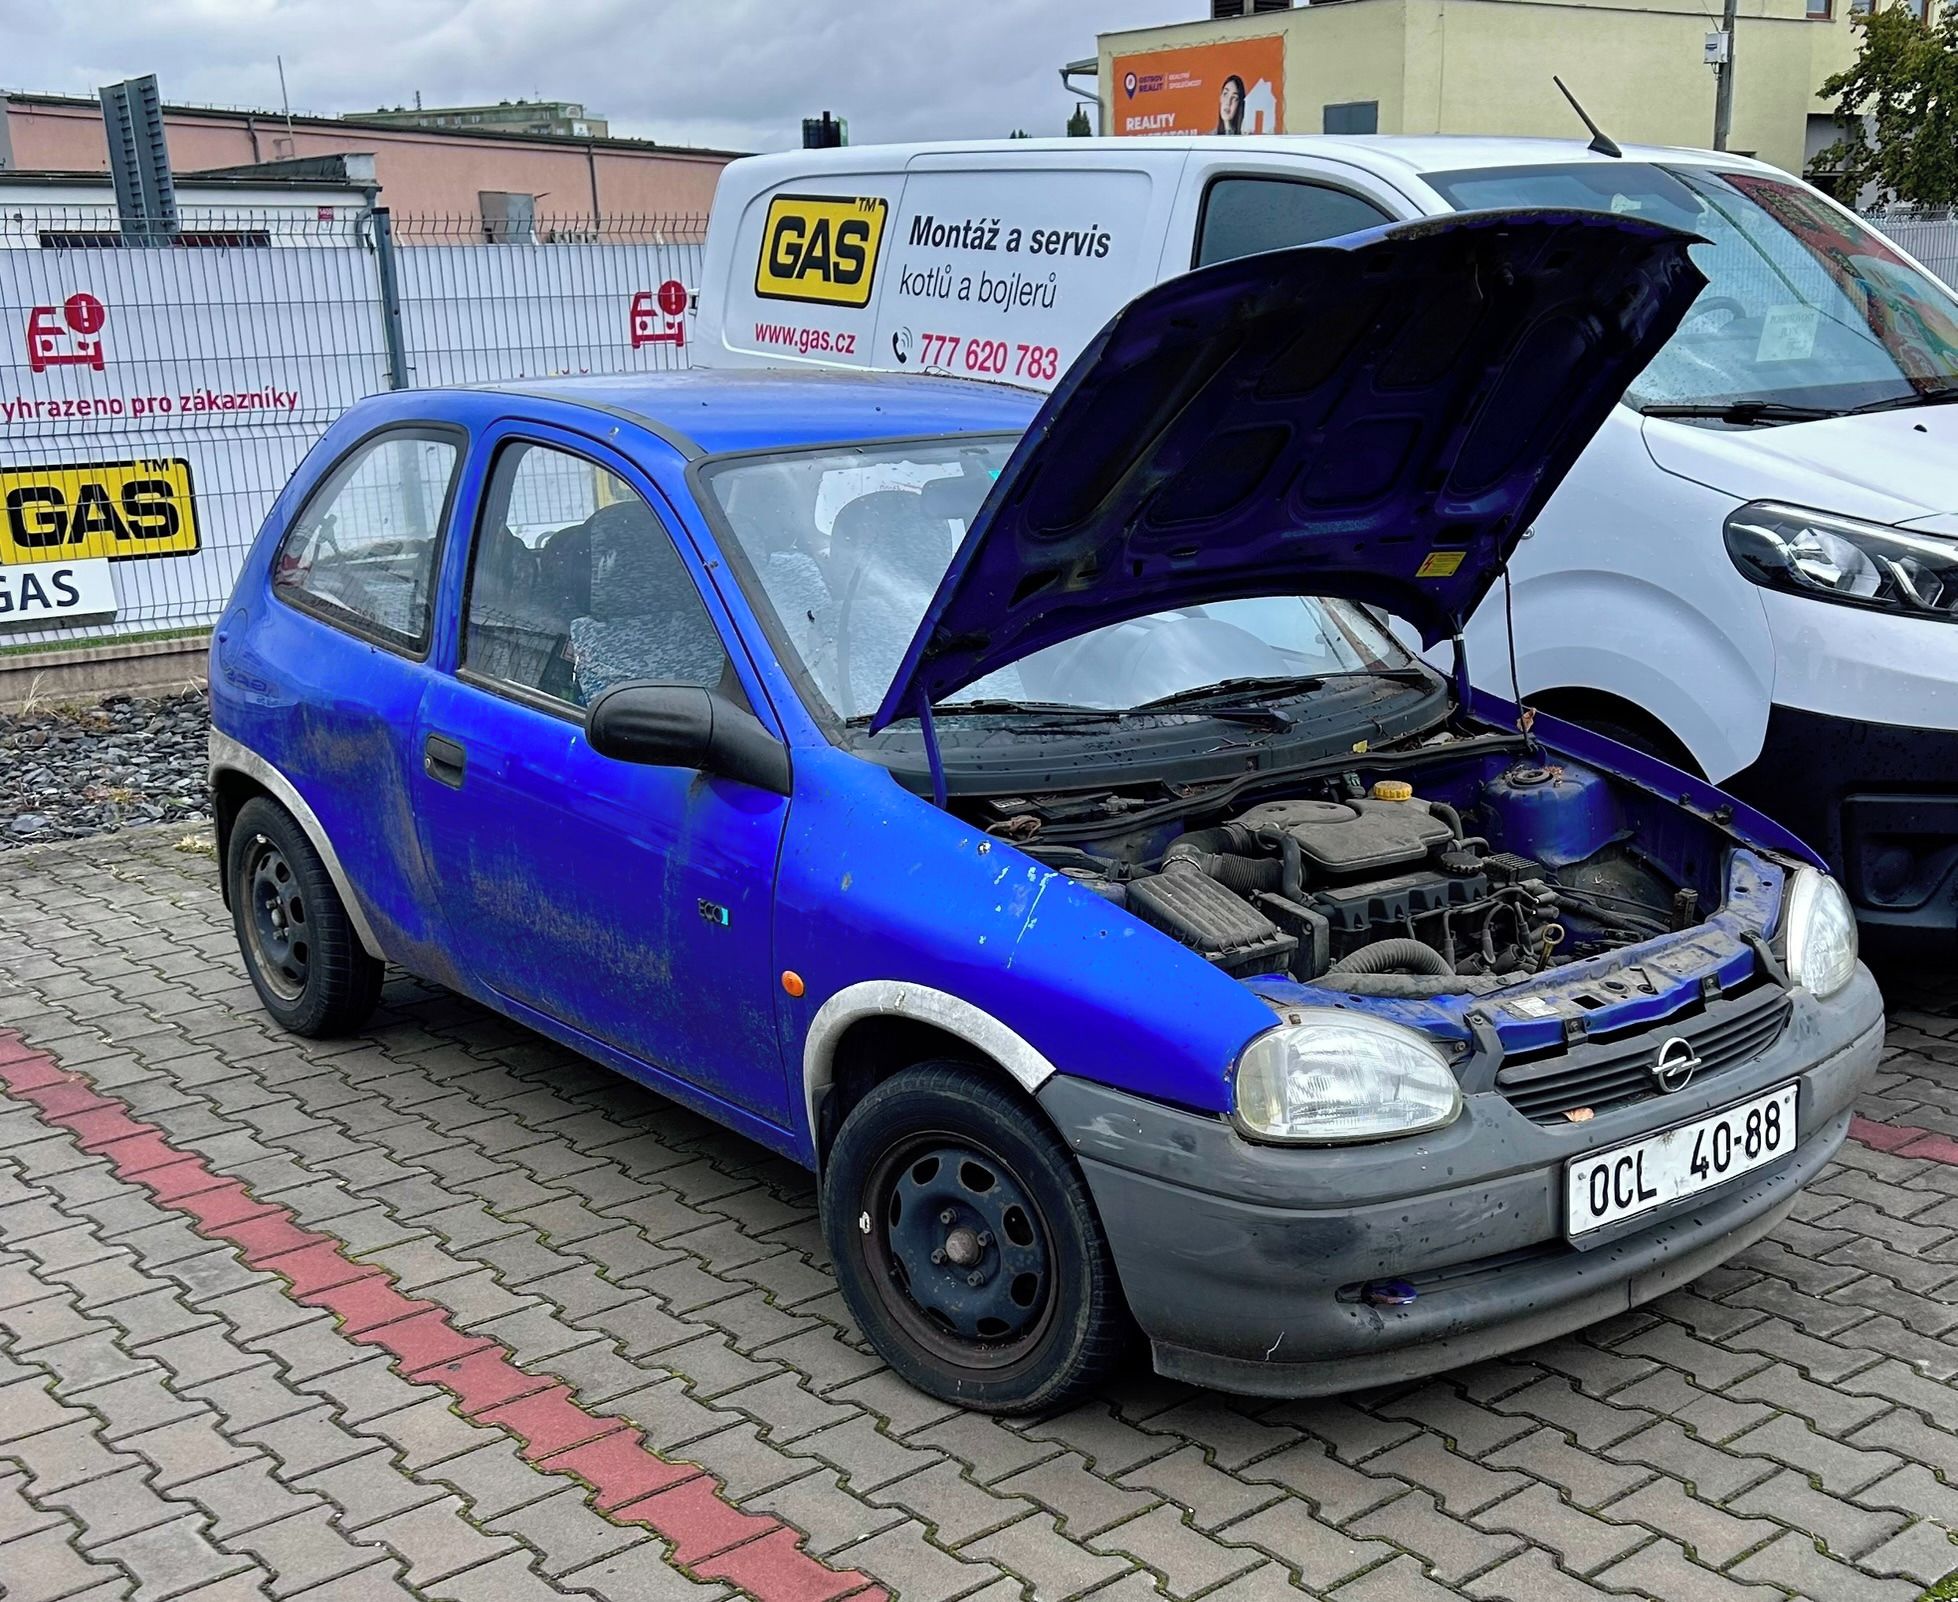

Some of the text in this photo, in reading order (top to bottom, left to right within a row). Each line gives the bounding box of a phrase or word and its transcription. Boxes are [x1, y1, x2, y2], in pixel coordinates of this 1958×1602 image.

[1125, 113, 1176, 131] REALITY
[858, 198, 876, 212] TM
[769, 215, 870, 285] GAS
[909, 215, 1111, 258] Montáž a servis
[900, 264, 1057, 313] kotlů a bojlerů
[755, 323, 856, 354] www.gas.cz
[920, 333, 1059, 381] 777 620 783
[0, 386, 298, 423] yhrazeno pro zákazníky
[140, 458, 169, 472] TM
[6, 480, 181, 548] GAS
[1589, 1100, 1781, 1217] OCL 40-88
